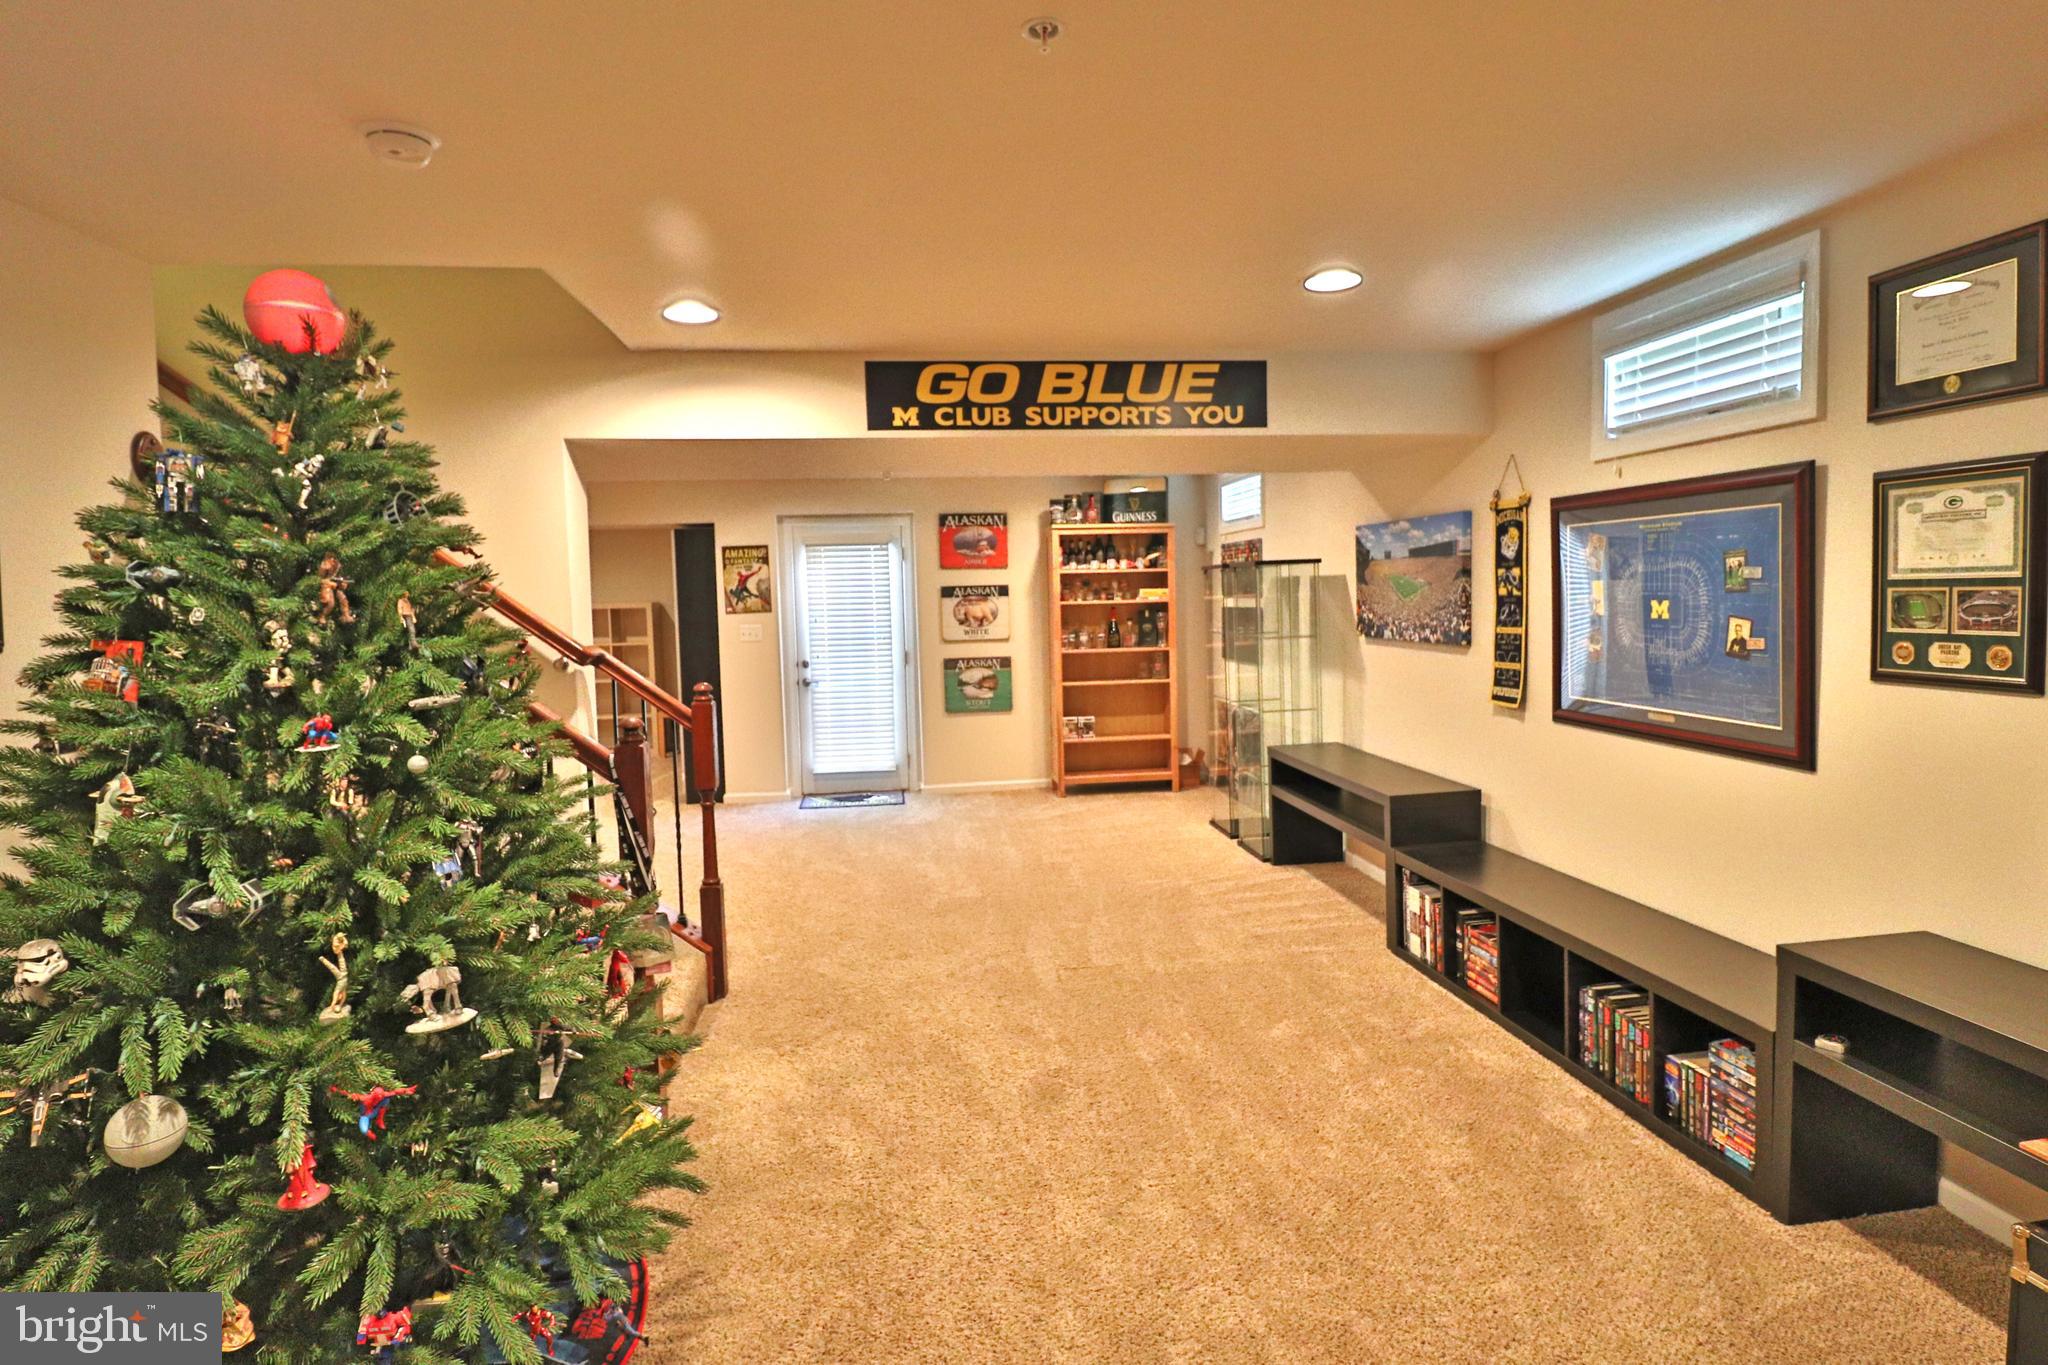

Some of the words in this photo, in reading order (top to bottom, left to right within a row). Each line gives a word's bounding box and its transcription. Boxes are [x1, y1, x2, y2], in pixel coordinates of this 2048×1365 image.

[915, 363, 1020, 404] GO
[1036, 363, 1220, 404] BLUE
[892, 407, 919, 427] M
[934, 406, 1011, 427] CLUB
[1025, 405, 1172, 427] SUPPORTS
[1184, 405, 1244, 426] YOU
[942, 515, 1004, 533] ALASKAN
[1112, 511, 1158, 523] GUINNESS
[952, 586, 1000, 600] ALASKAN
[1650, 599, 1670, 620] M
[955, 658, 1000, 673] ALASKAN
